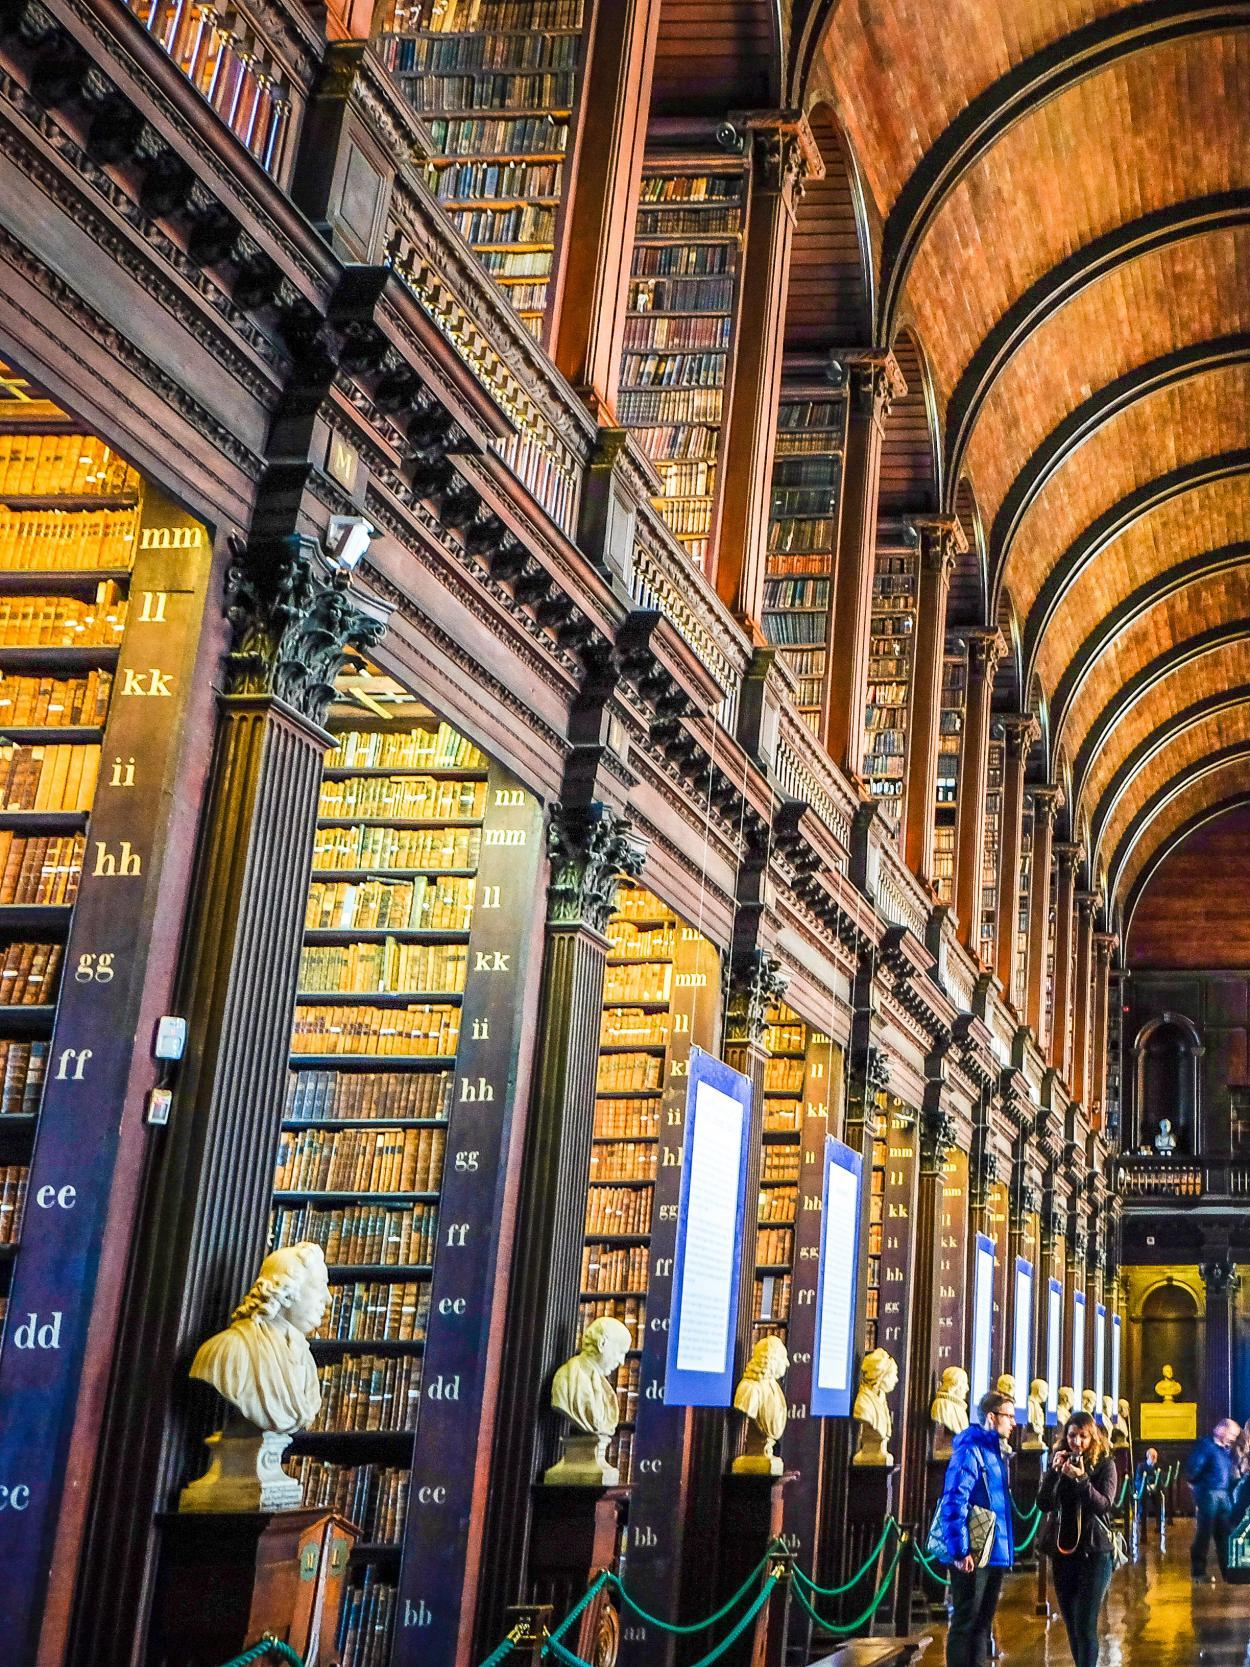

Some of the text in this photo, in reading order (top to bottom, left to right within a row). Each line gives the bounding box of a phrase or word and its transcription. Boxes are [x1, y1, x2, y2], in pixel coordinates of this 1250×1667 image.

[336, 442, 352, 480] M
[140, 525, 202, 550] mm
[138, 592, 167, 623] ll
[120, 668, 174, 697] kk
[109, 757, 135, 787] ii
[495, 789, 525, 807] nn
[485, 829, 527, 846] mm
[92, 842, 142, 877] hh
[482, 887, 500, 908] ll
[75, 951, 115, 983] gg
[474, 952, 510, 971] kk
[675, 972, 707, 987] mm
[472, 1018, 489, 1039] ii
[674, 1014, 689, 1033] ll
[54, 1047, 92, 1080] ff
[460, 1079, 495, 1102] hh
[668, 1108, 682, 1125] ii
[808, 1103, 828, 1117] kk
[455, 1148, 479, 1171] gg
[890, 1147, 913, 1157] mm
[37, 1183, 76, 1209] ee
[804, 1196, 822, 1210] hh
[889, 1204, 908, 1218] kk
[446, 1224, 470, 1246] ff
[800, 1246, 819, 1259] gg
[655, 1259, 672, 1277] ff
[886, 1268, 903, 1281] hh
[439, 1296, 466, 1315] ee
[14, 1312, 63, 1350] dd
[793, 1352, 810, 1363] ee
[427, 1376, 459, 1401] dd
[788, 1404, 806, 1419] dd
[639, 1457, 662, 1474] cc
[419, 1485, 446, 1504] cc
[634, 1526, 657, 1548] bb
[404, 1601, 431, 1627] bb
